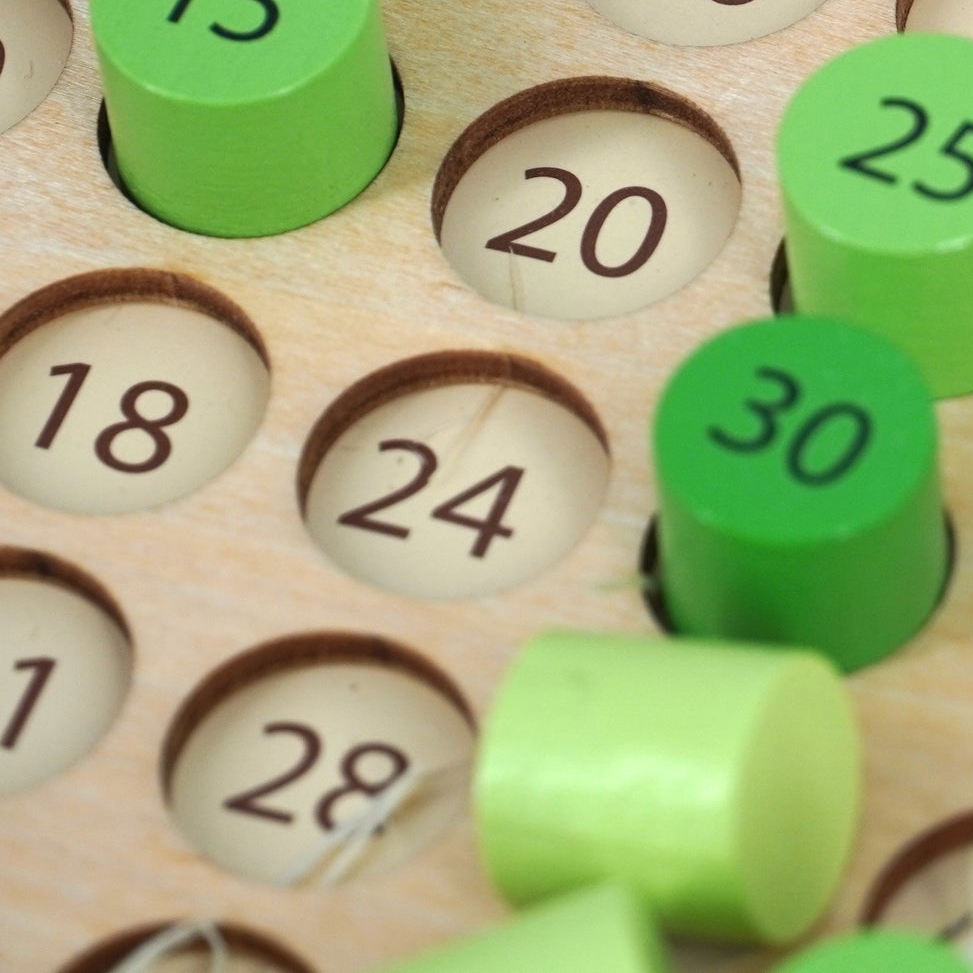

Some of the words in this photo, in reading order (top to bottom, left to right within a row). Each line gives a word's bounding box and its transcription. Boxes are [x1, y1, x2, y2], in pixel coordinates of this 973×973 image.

[485, 167, 669, 279] 20
[34, 362, 190, 474] 18
[706, 366, 875, 487] 30
[336, 439, 526, 559] 24
[222, 720, 409, 835] 28
